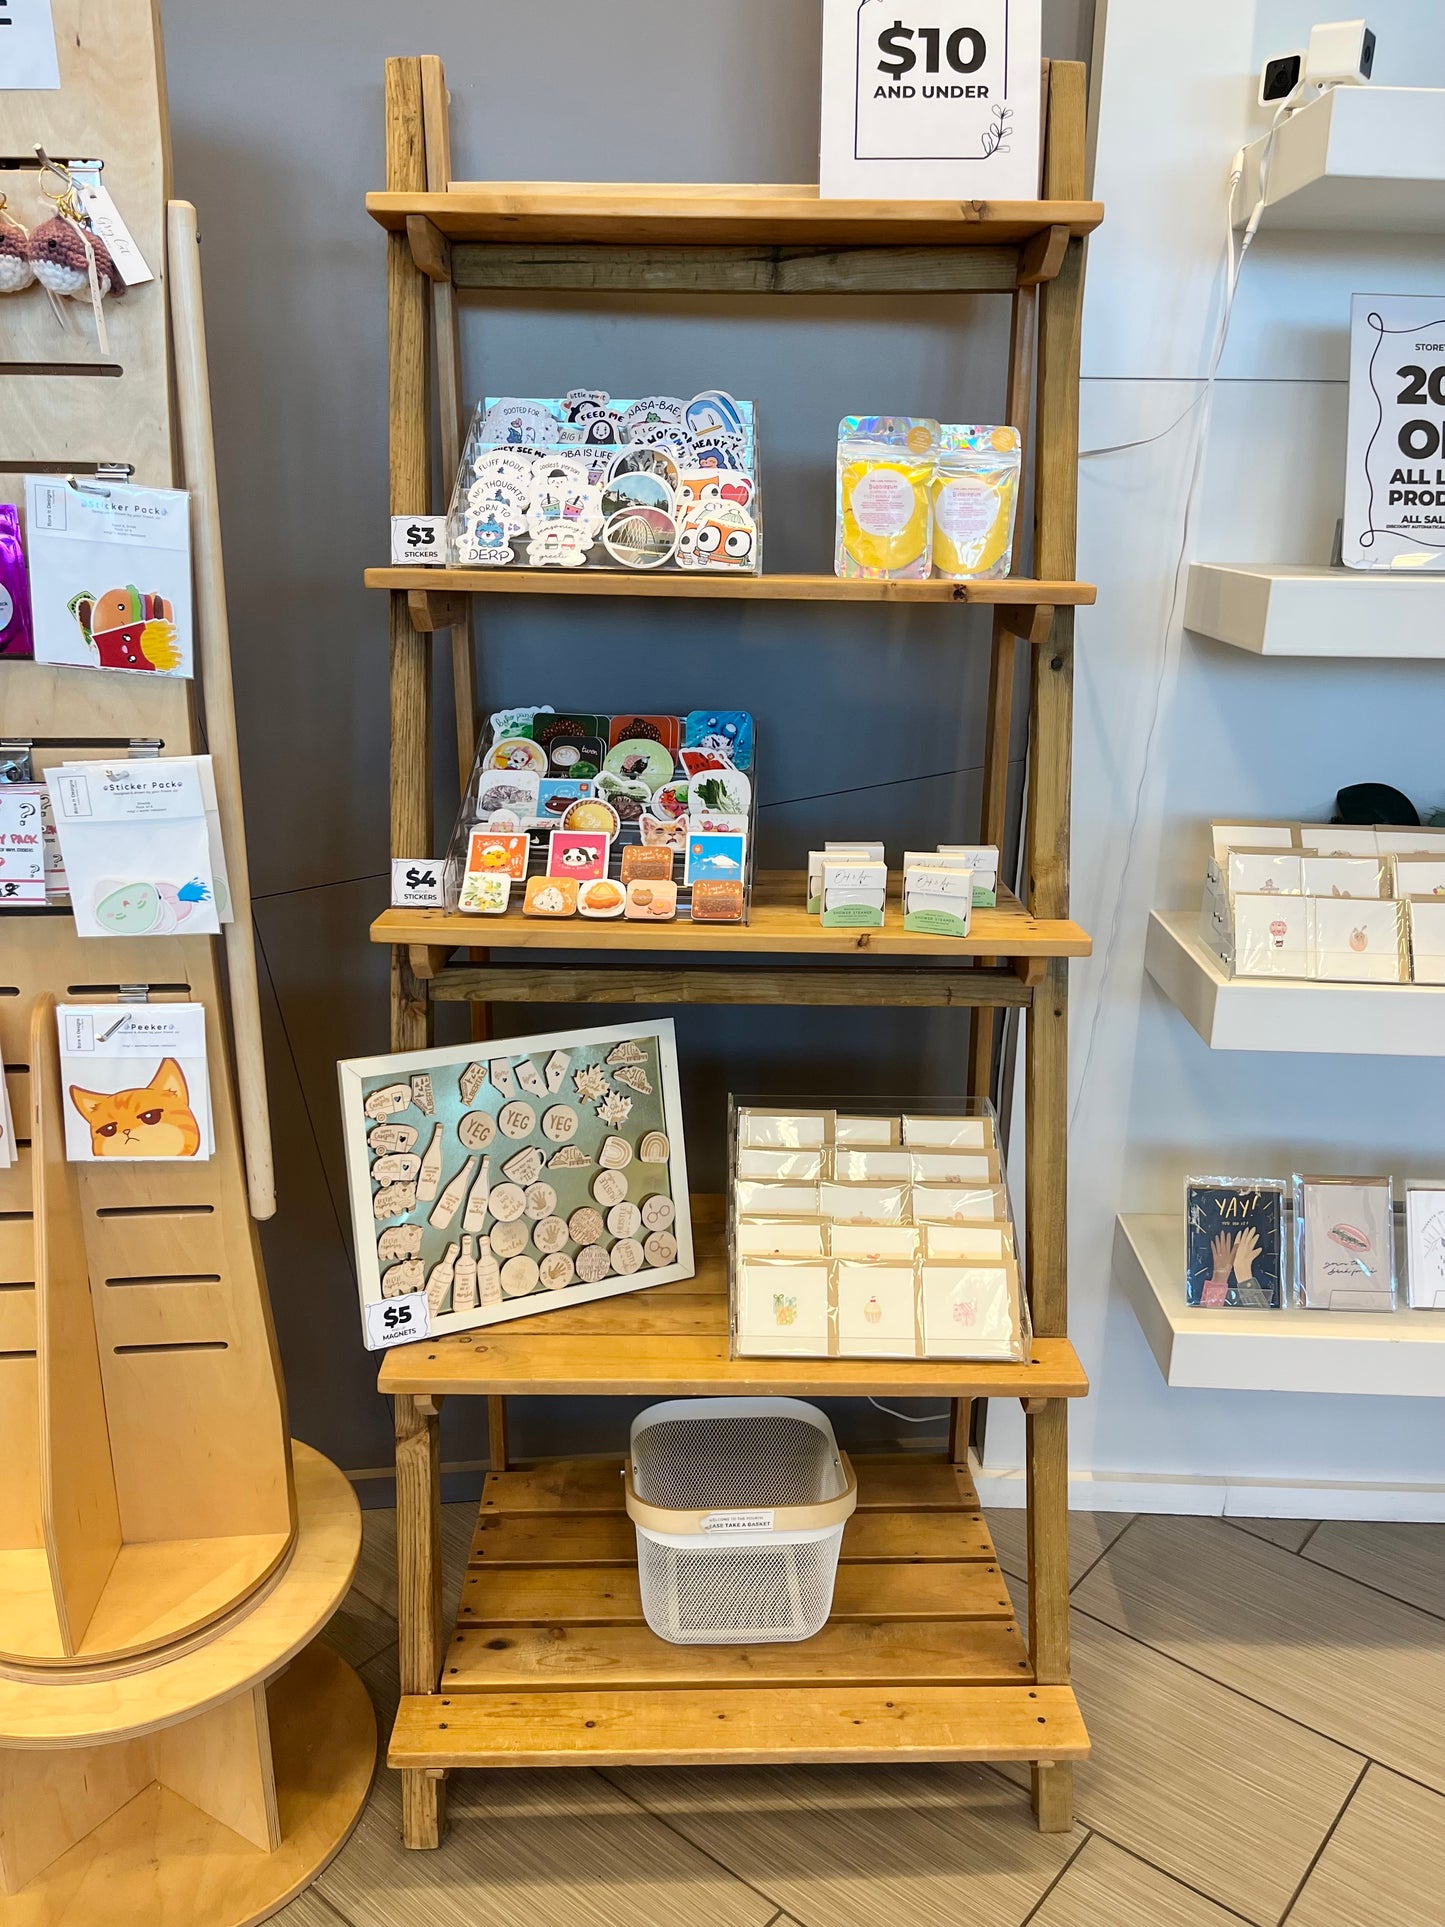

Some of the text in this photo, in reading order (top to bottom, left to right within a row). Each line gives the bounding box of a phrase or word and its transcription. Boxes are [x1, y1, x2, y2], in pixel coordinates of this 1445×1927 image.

[877, 20, 987, 81] $10
[873, 85, 989, 99] AND UNDER
[1414, 343, 1445, 352] STORE
[527, 407, 540, 417] FOR
[580, 410, 625, 423] FEED ME
[560, 432, 576, 441] BIG
[691, 438, 728, 450] HEAVY
[582, 449, 592, 457] IS
[594, 450, 613, 461] LIFE
[478, 459, 525, 473] FLUFF MODE
[1389, 468, 1431, 485] ALL
[473, 479, 526, 502] NO THOUGHTS
[88, 500, 129, 512] Sticker
[134, 505, 160, 515] Pack
[472, 503, 511, 518] BORN TO
[1401, 515, 1422, 523] ALL
[406, 524, 436, 547] $3
[467, 548, 510, 561] DERP
[109, 781, 176, 791] Sticker Pack
[10, 833, 39, 845] PACK
[405, 867, 437, 890] $4
[404, 893, 437, 901] STICKERS
[131, 1023, 168, 1031] Peeker
[465, 1075, 485, 1105] ALBERTA
[425, 1082, 435, 1115] ALBERTA
[506, 1109, 530, 1130] YEG
[550, 1114, 573, 1132] YEG
[466, 1118, 491, 1142] YEG
[1214, 1194, 1259, 1219] YAY!
[623, 1241, 638, 1268] HUSTLE
[383, 1305, 412, 1329] $5
[382, 1327, 417, 1341] MAGNETS
